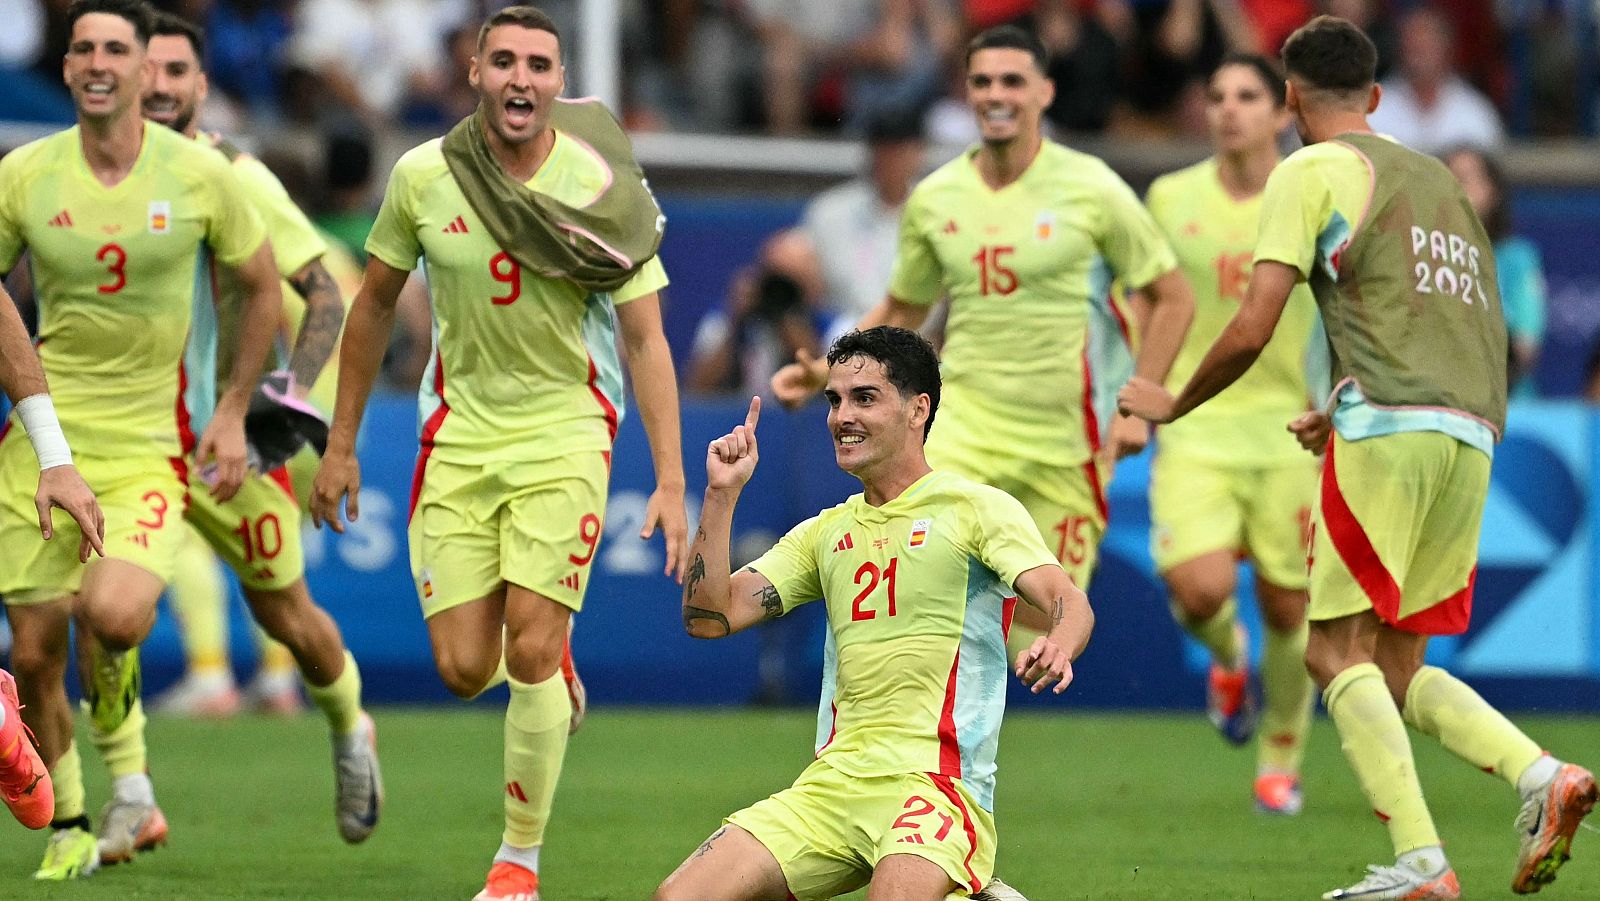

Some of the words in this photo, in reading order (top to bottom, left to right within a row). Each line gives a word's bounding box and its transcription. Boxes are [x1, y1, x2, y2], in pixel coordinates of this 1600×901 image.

[96, 242, 127, 294] 3
[488, 250, 521, 306] 9
[972, 245, 1019, 297] 15
[136, 490, 168, 530] 3
[233, 511, 283, 563] 10
[568, 512, 601, 567] 9
[1053, 515, 1087, 565] 15
[851, 556, 898, 622] 21
[891, 795, 954, 842] 21
